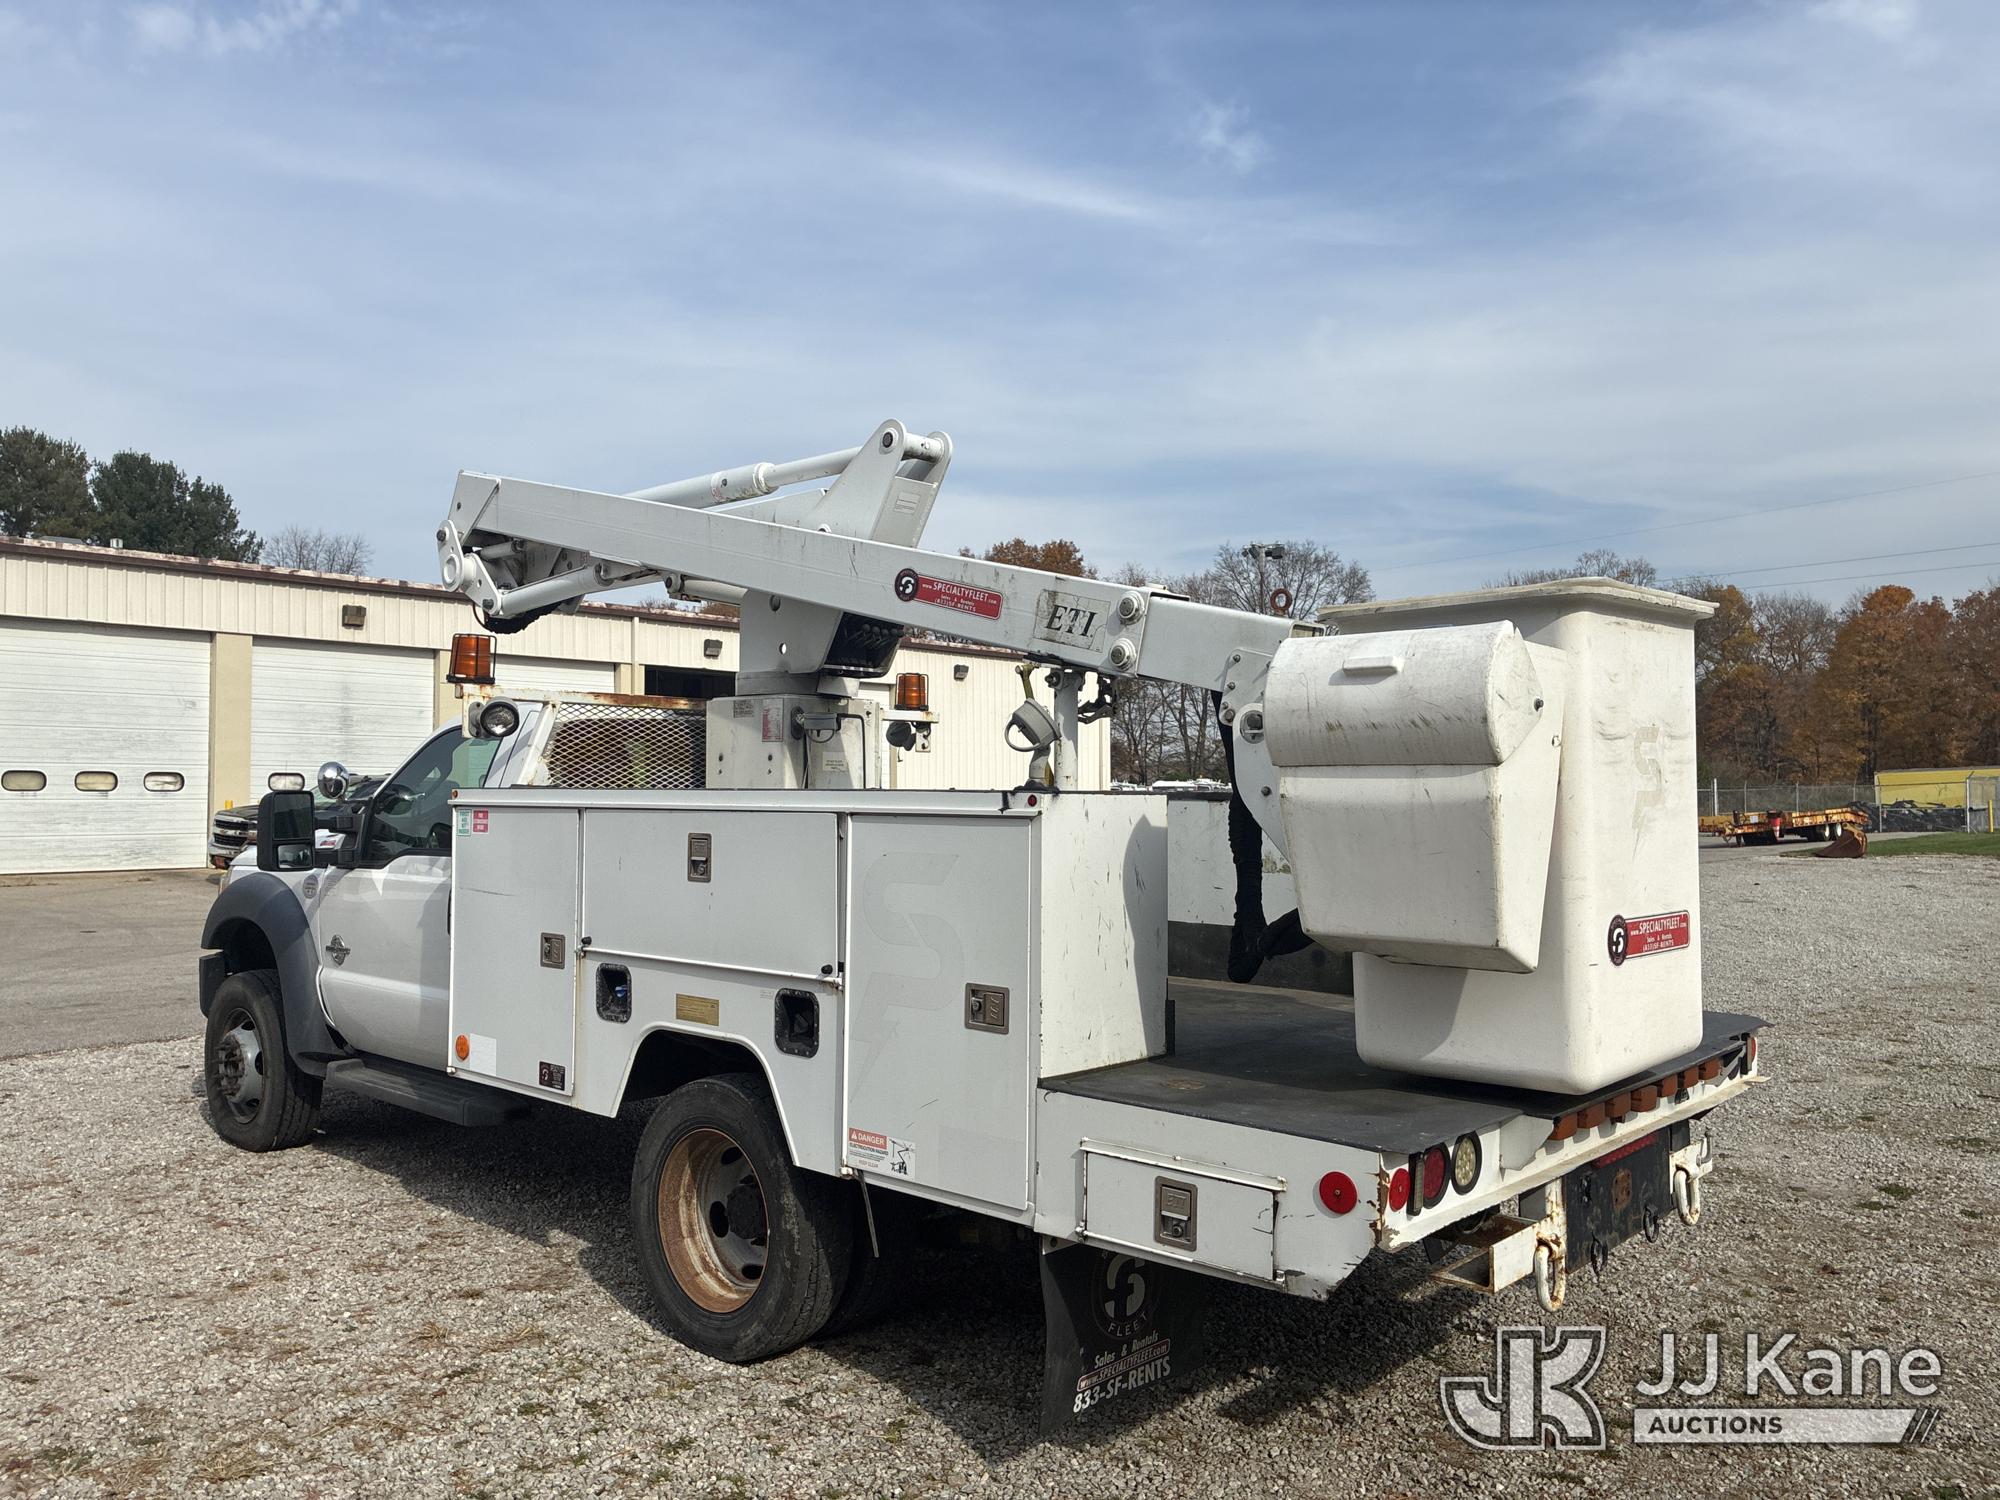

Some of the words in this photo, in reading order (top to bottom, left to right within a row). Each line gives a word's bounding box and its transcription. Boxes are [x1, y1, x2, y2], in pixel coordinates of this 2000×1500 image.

[858, 1132, 885, 1145] DANGER
[1107, 1310, 1148, 1338] FLEET
[1079, 1344, 1168, 1389] www.SPECIALTYFLEET.com
[1094, 1351, 1116, 1370] Sales
[1121, 1343, 1128, 1355] &
[1131, 1330, 1159, 1353] Rentals
[1073, 1356, 1171, 1413] 833-SF-RENTS
